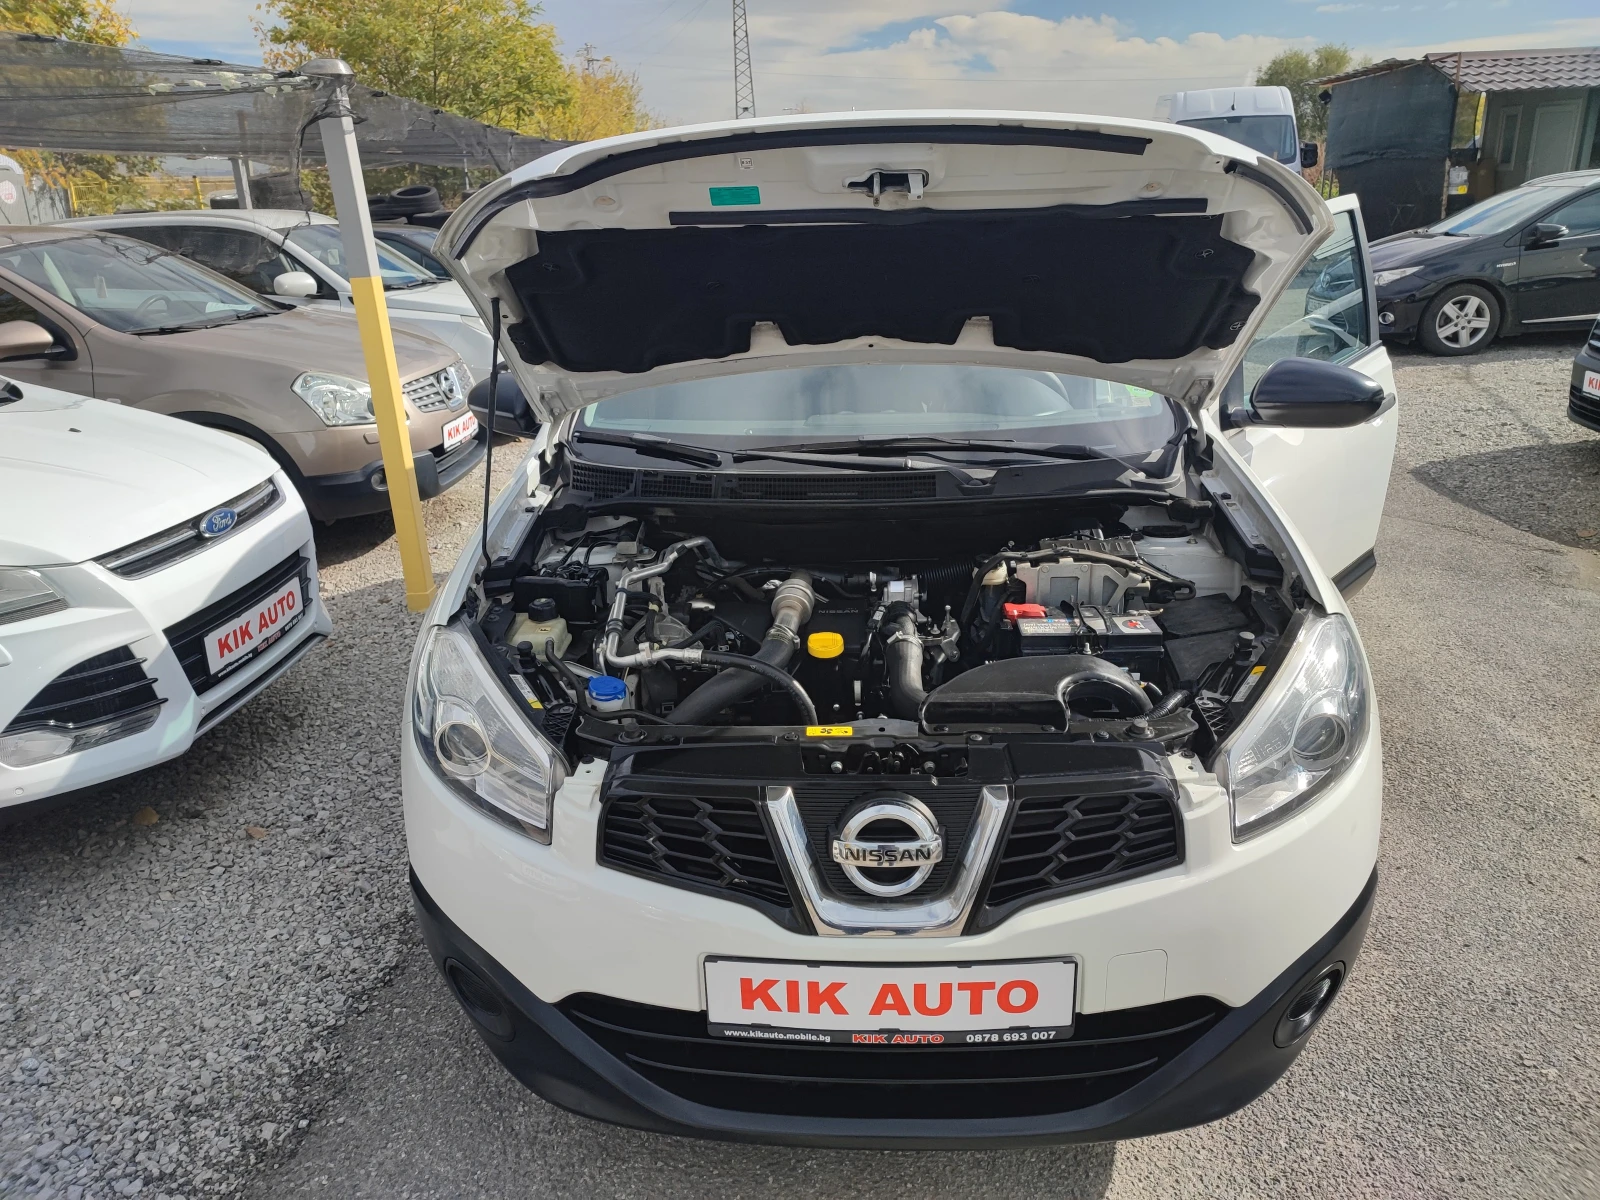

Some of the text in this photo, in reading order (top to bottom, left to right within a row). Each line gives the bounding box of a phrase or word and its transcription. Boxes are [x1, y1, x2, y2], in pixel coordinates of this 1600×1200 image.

[447, 424, 461, 441] KIK
[212, 512, 233, 532] Ford
[217, 620, 254, 659] KIK
[258, 590, 296, 635] AUTO
[844, 846, 932, 862] NISSAN
[739, 977, 1039, 1017] KIK AUTO
[724, 1029, 1057, 1044] www.kikauto.mobile.bg KIK AUTO 0878 693 007
